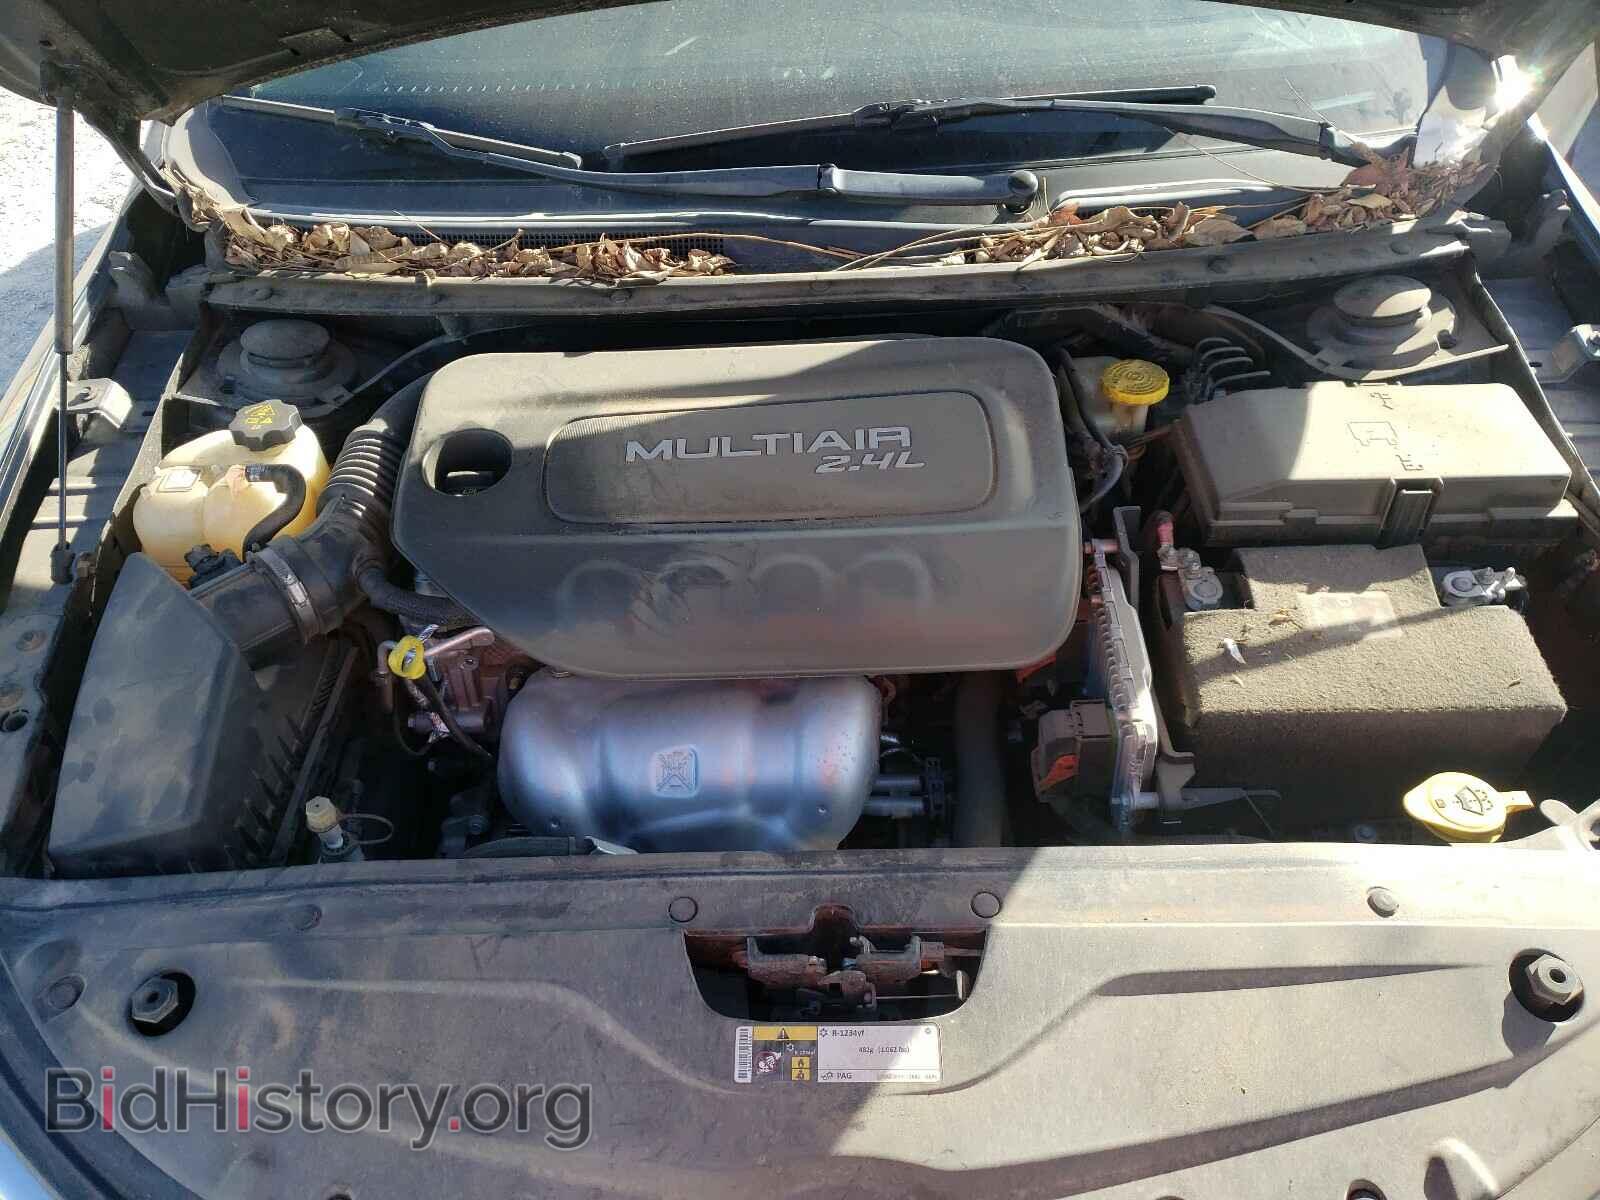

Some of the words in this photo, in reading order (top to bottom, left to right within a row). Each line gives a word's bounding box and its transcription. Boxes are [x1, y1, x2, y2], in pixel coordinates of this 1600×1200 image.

[625, 426, 912, 463] MULTIAIR
[814, 450, 926, 474] 2.4L
[836, 1072, 853, 1080] PAG
